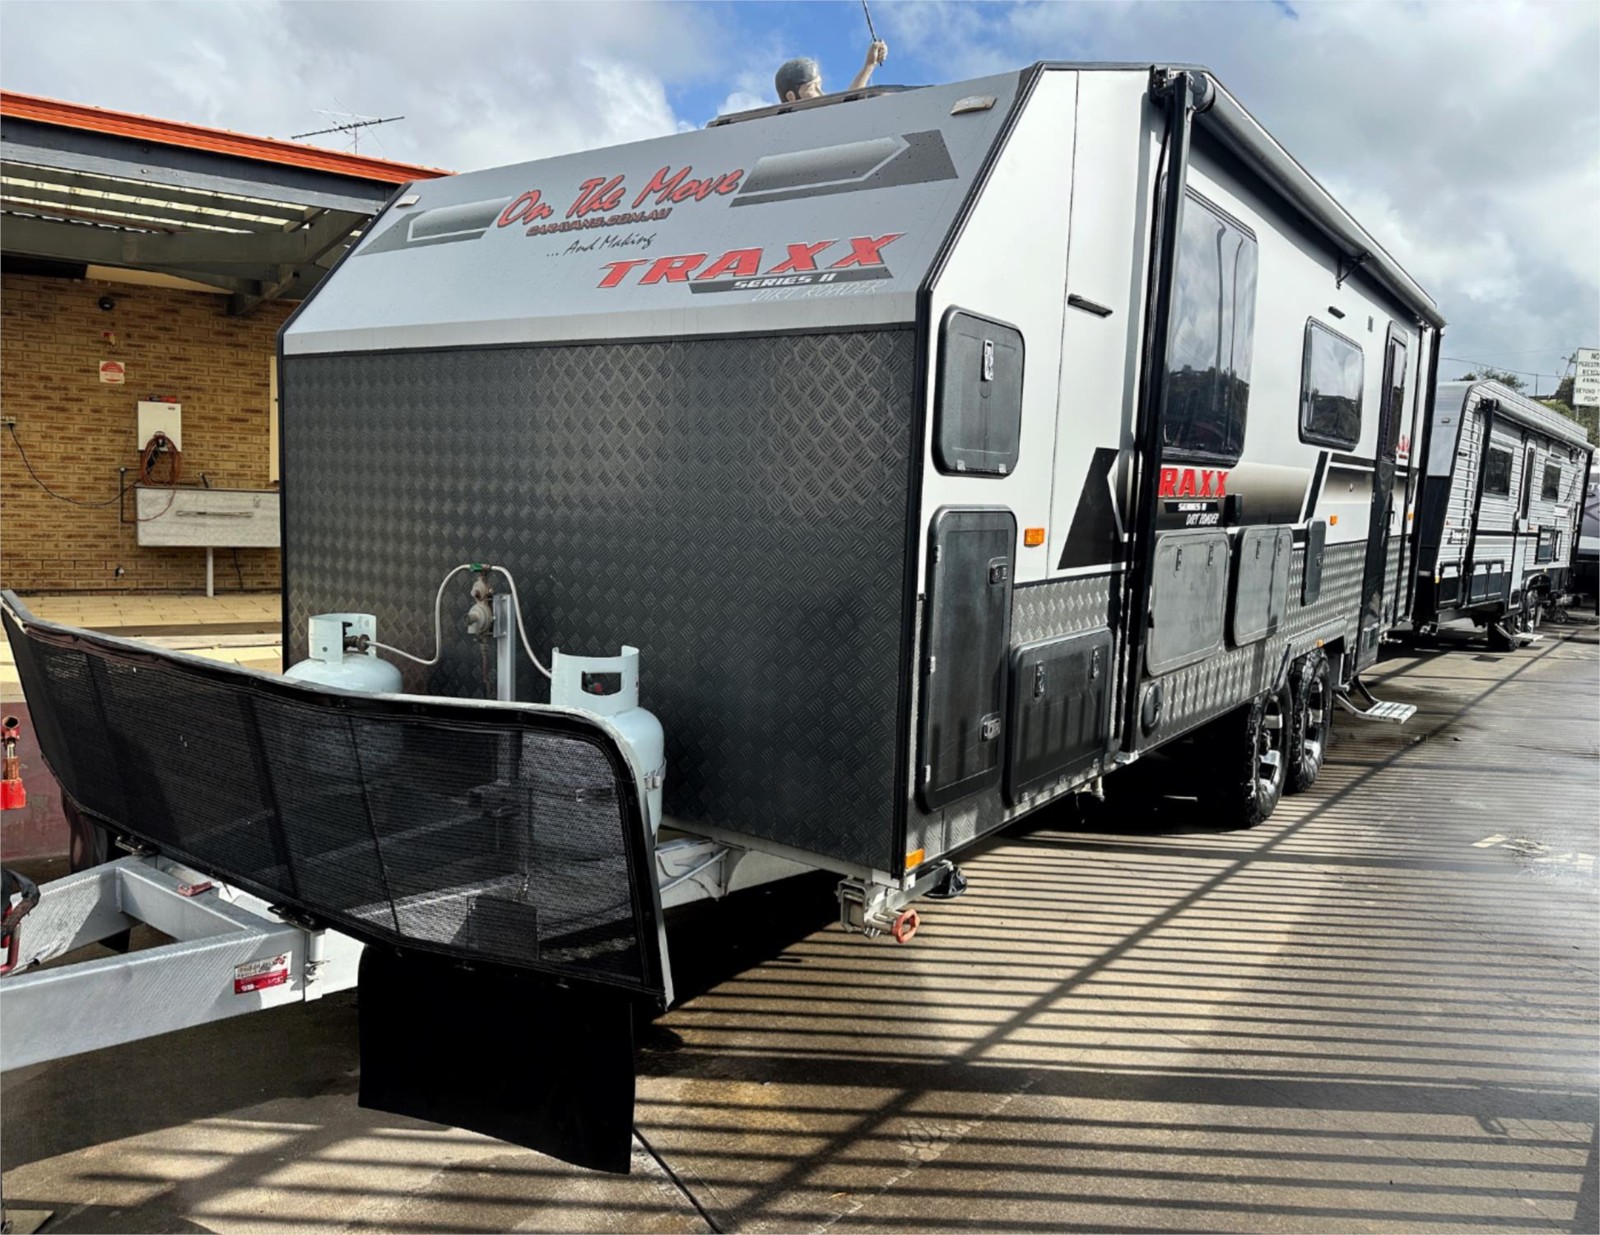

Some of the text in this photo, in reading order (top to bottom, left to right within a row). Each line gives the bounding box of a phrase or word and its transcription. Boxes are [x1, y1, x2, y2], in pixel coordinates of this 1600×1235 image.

[497, 165, 745, 228] On The Move
[526, 207, 673, 236] CARAVANS.COM.AU
[599, 233, 658, 250] Making
[596, 232, 907, 289] TRAXX
[733, 274, 813, 290] SERIES
[1158, 467, 1229, 498] RAXX
